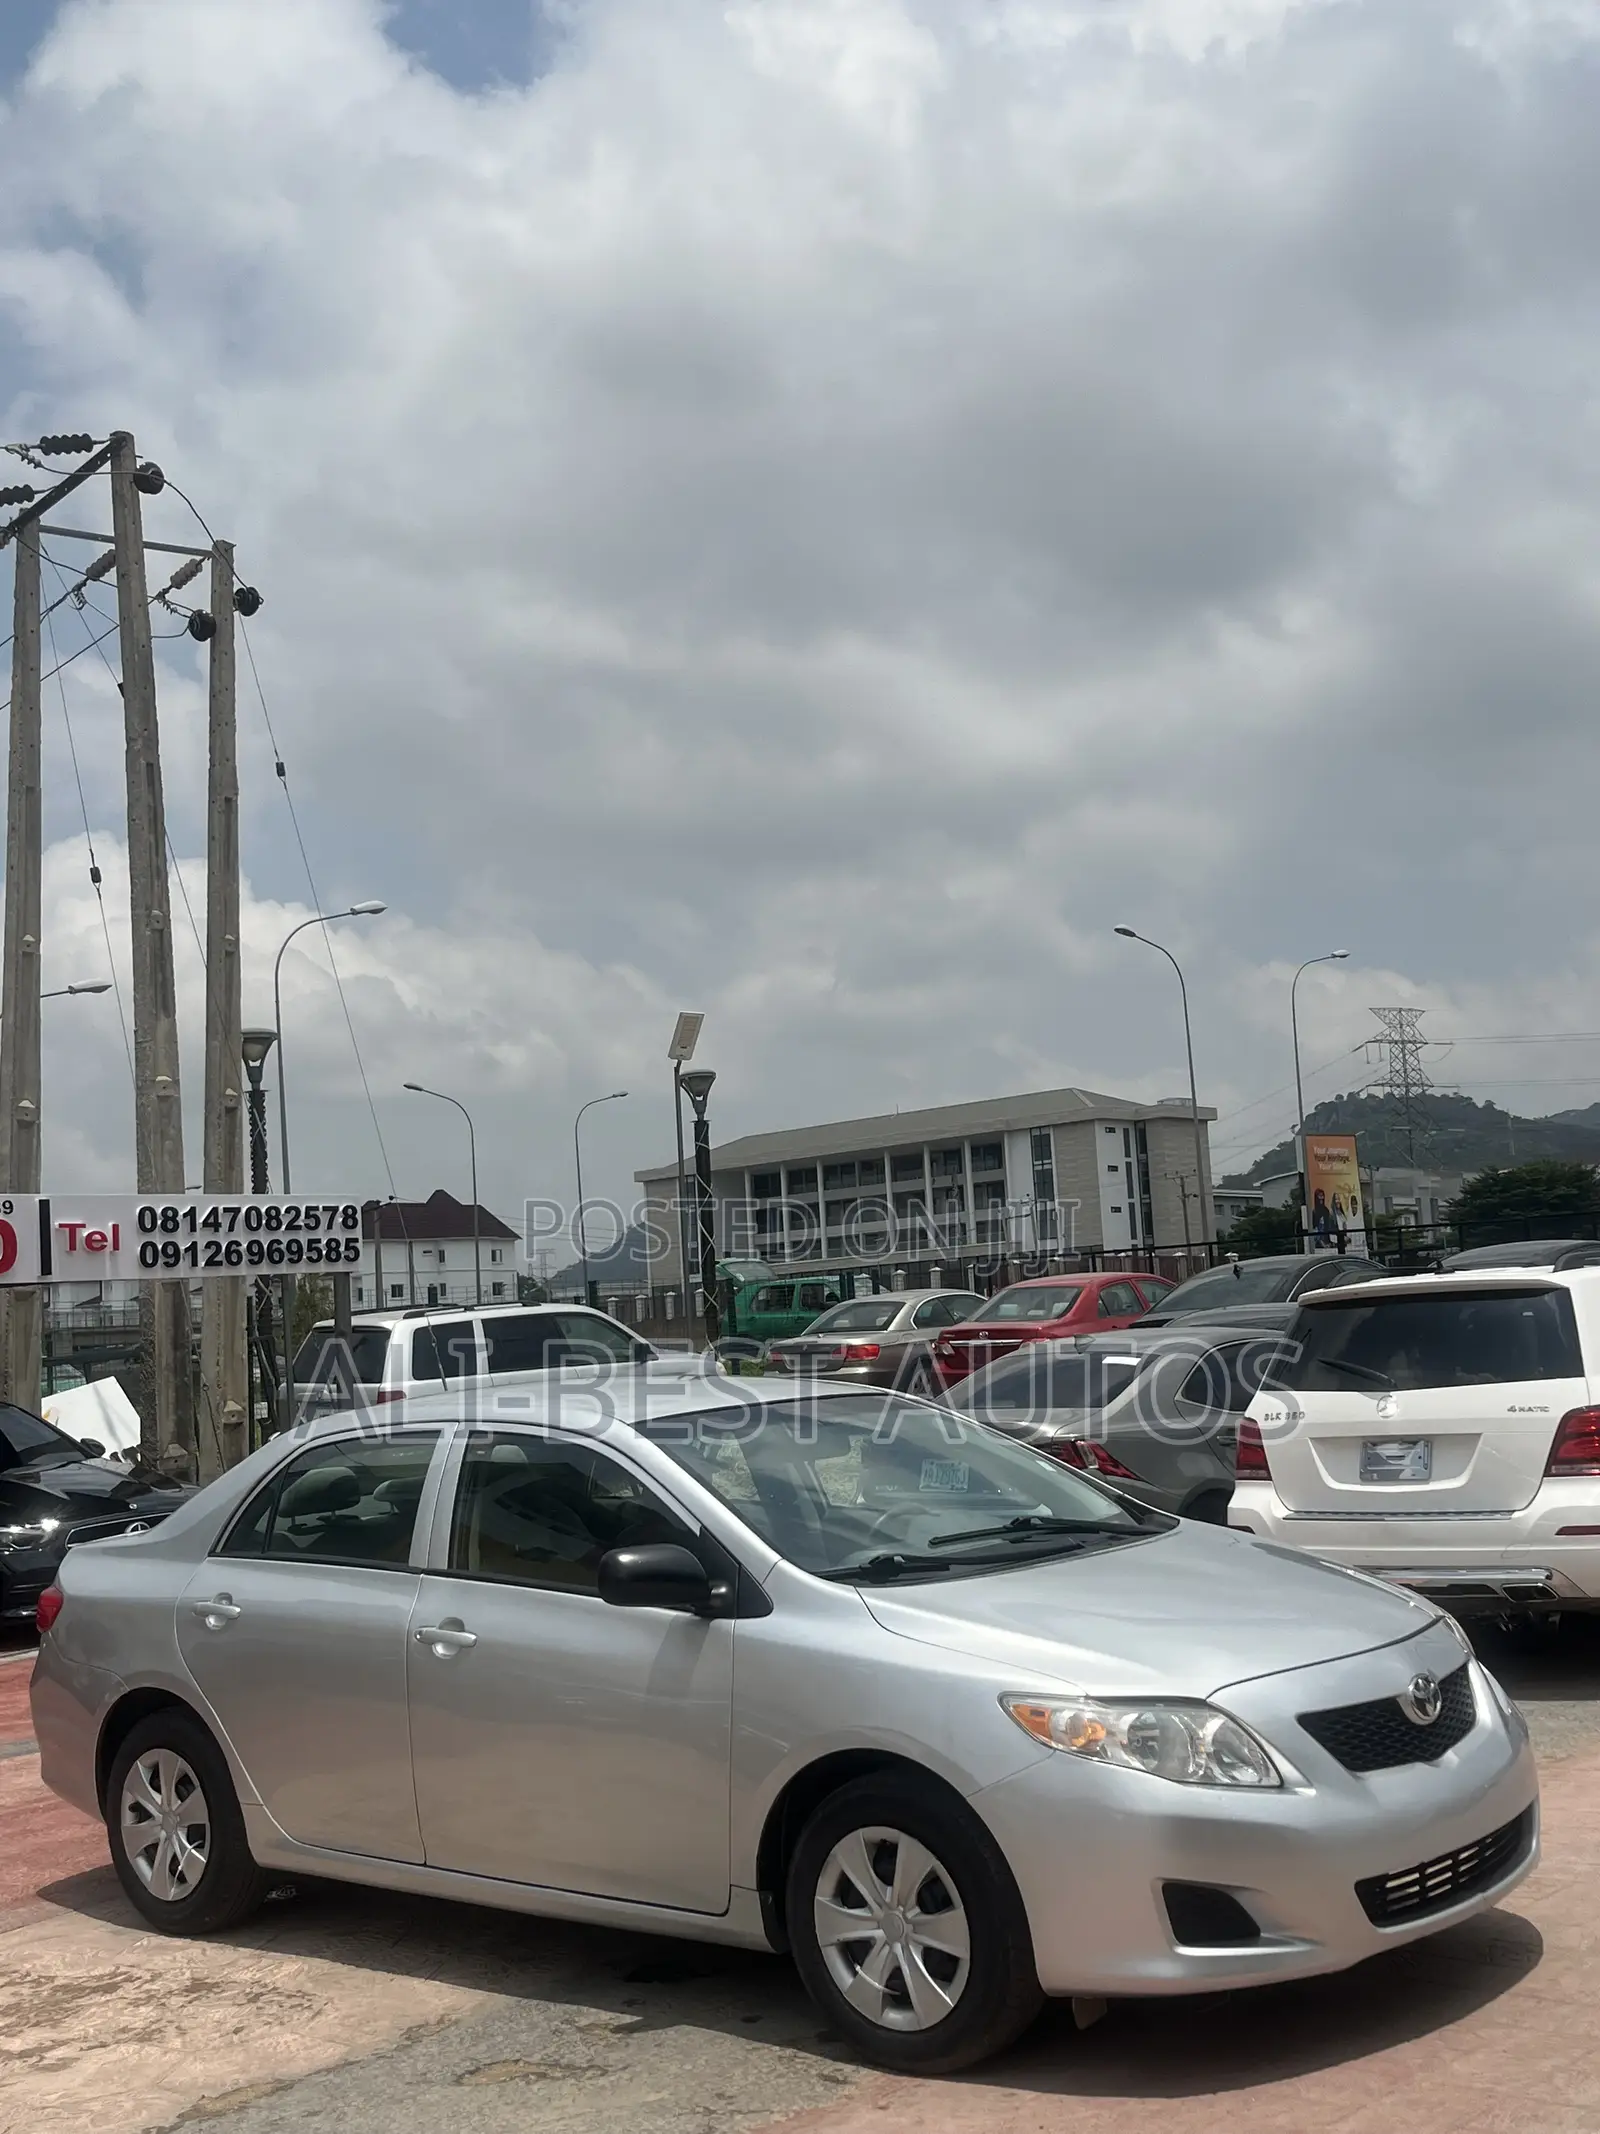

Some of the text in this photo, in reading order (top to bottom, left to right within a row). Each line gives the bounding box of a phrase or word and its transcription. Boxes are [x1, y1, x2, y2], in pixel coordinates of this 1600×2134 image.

[137, 1204, 359, 1233] 08147082578
[58, 1223, 120, 1252] Tel
[138, 1237, 361, 1268] 09126969585
